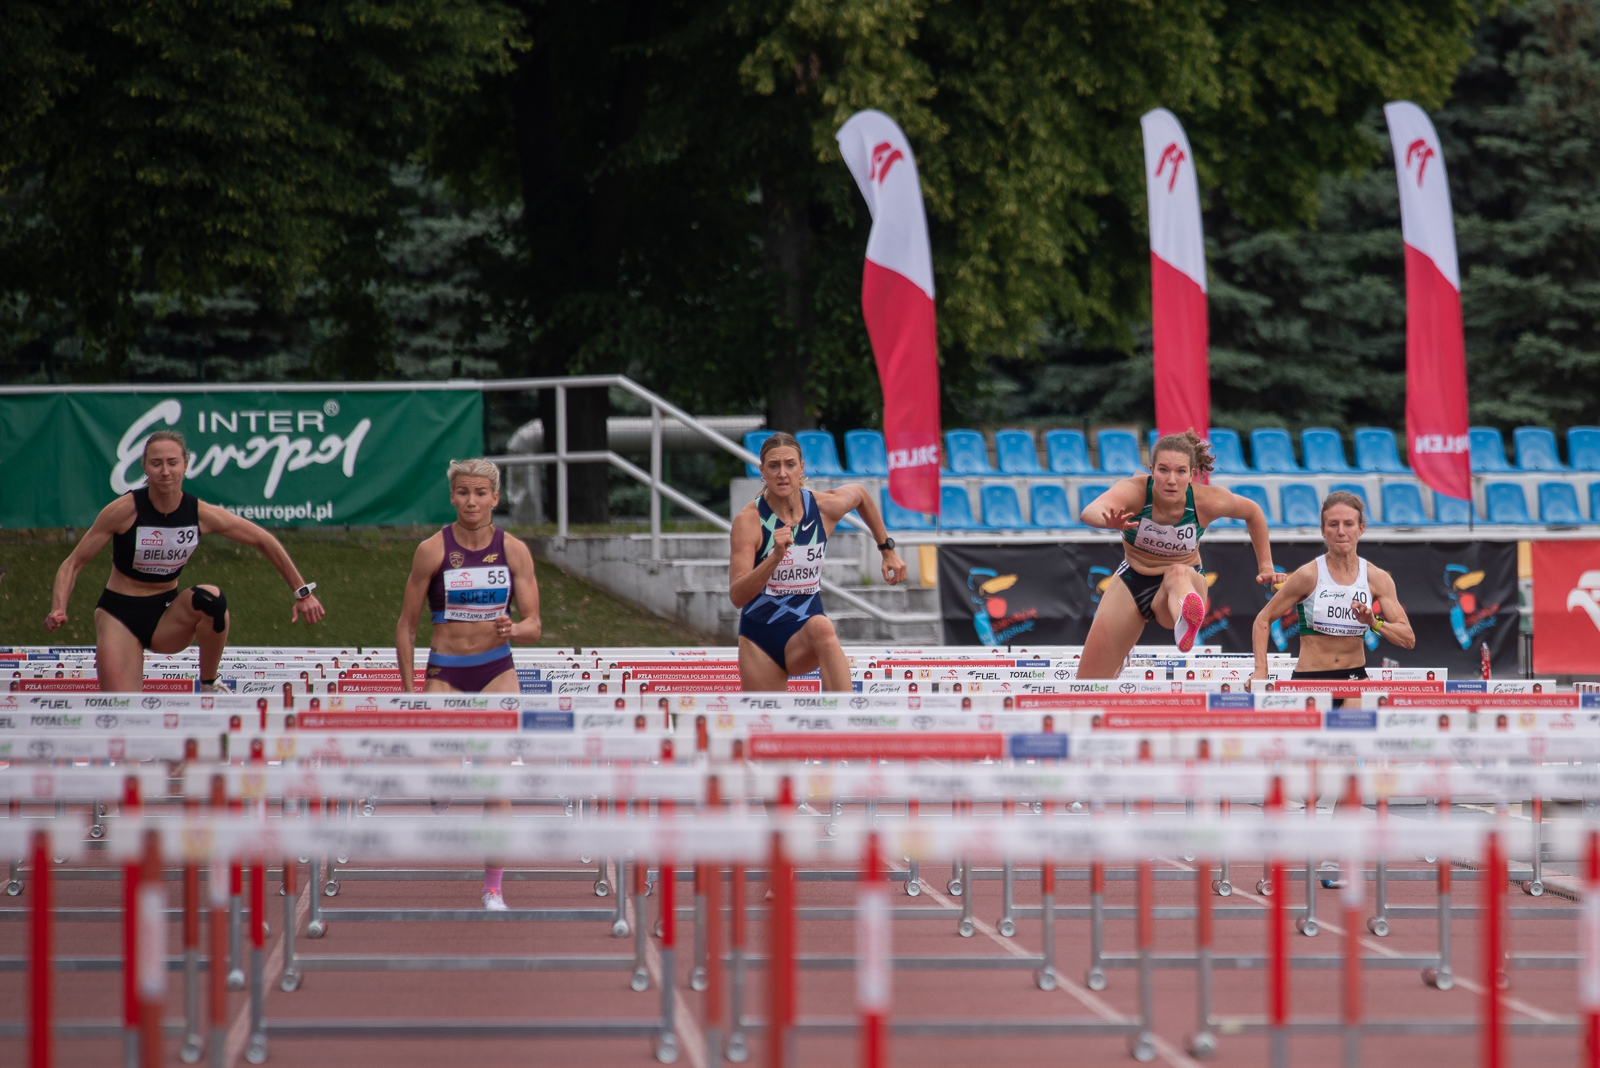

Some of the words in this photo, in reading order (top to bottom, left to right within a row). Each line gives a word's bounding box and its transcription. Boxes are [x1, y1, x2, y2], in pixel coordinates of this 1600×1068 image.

[199, 412, 325, 433] INTER
[177, 529, 195, 544] 39
[1142, 537, 1187, 551] SŁOCKA
[143, 549, 187, 560] BIELSKA
[806, 547, 823, 562] 54
[488, 570, 506, 584] 55
[771, 566, 819, 581] LIGARSKA
[460, 591, 496, 604] SUŁEK
[1352, 591, 1367, 604] 40
[450, 611, 482, 620] WARSZAWA
[483, 612, 497, 620] 2022
[1317, 626, 1346, 635] WARSZAWA
[975, 672, 1001, 680] FUEL
[1010, 670, 1045, 679] TOTALbet
[1031, 686, 1059, 694] FUEL
[1069, 683, 1109, 692] TOTALbet
[1141, 685, 1161, 693] Okęcie
[40, 700, 73, 709] FUEL
[85, 697, 130, 708] TOTALbet
[400, 701, 432, 710] FUEL
[443, 698, 488, 708] TOTALbet
[750, 700, 781, 709] FUEL
[793, 697, 838, 707] TOTALbet
